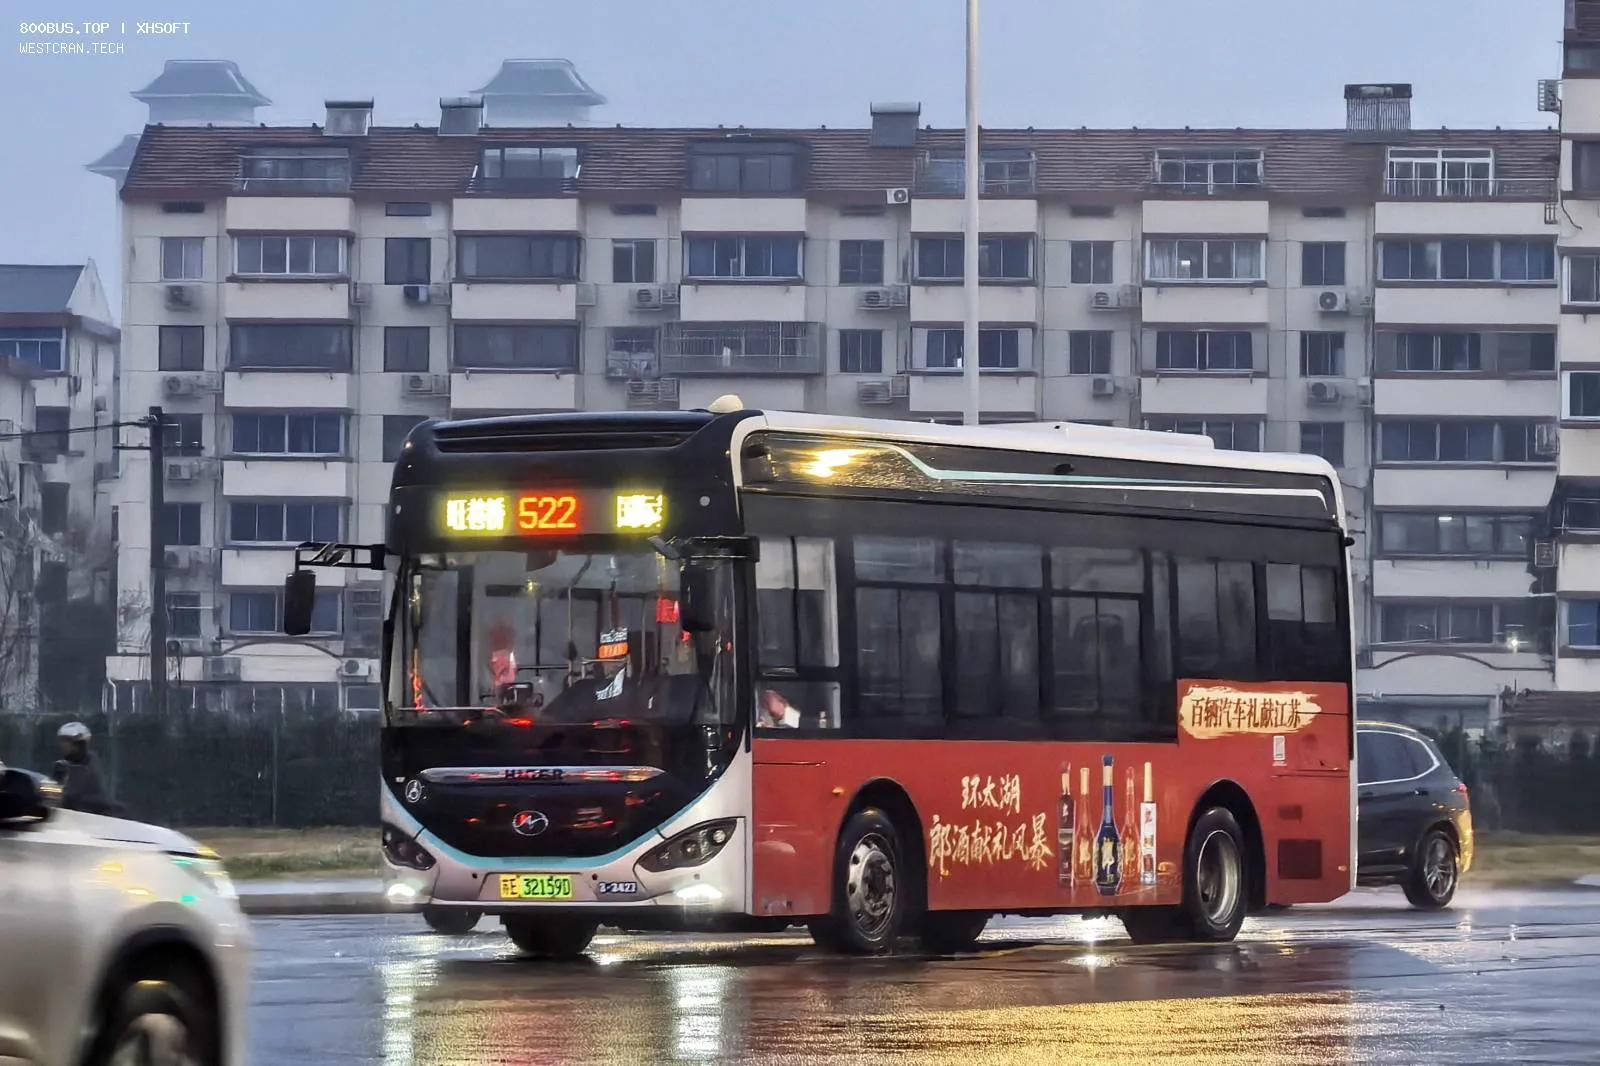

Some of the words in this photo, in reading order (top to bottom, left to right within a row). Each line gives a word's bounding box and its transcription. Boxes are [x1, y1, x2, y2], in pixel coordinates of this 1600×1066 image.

[519, 496, 577, 529] 522
[1191, 696, 1301, 729] 百辆汽车礼献江苏
[961, 774, 1021, 816] 环太湖
[929, 812, 1055, 877] 郎酒献礼风暴
